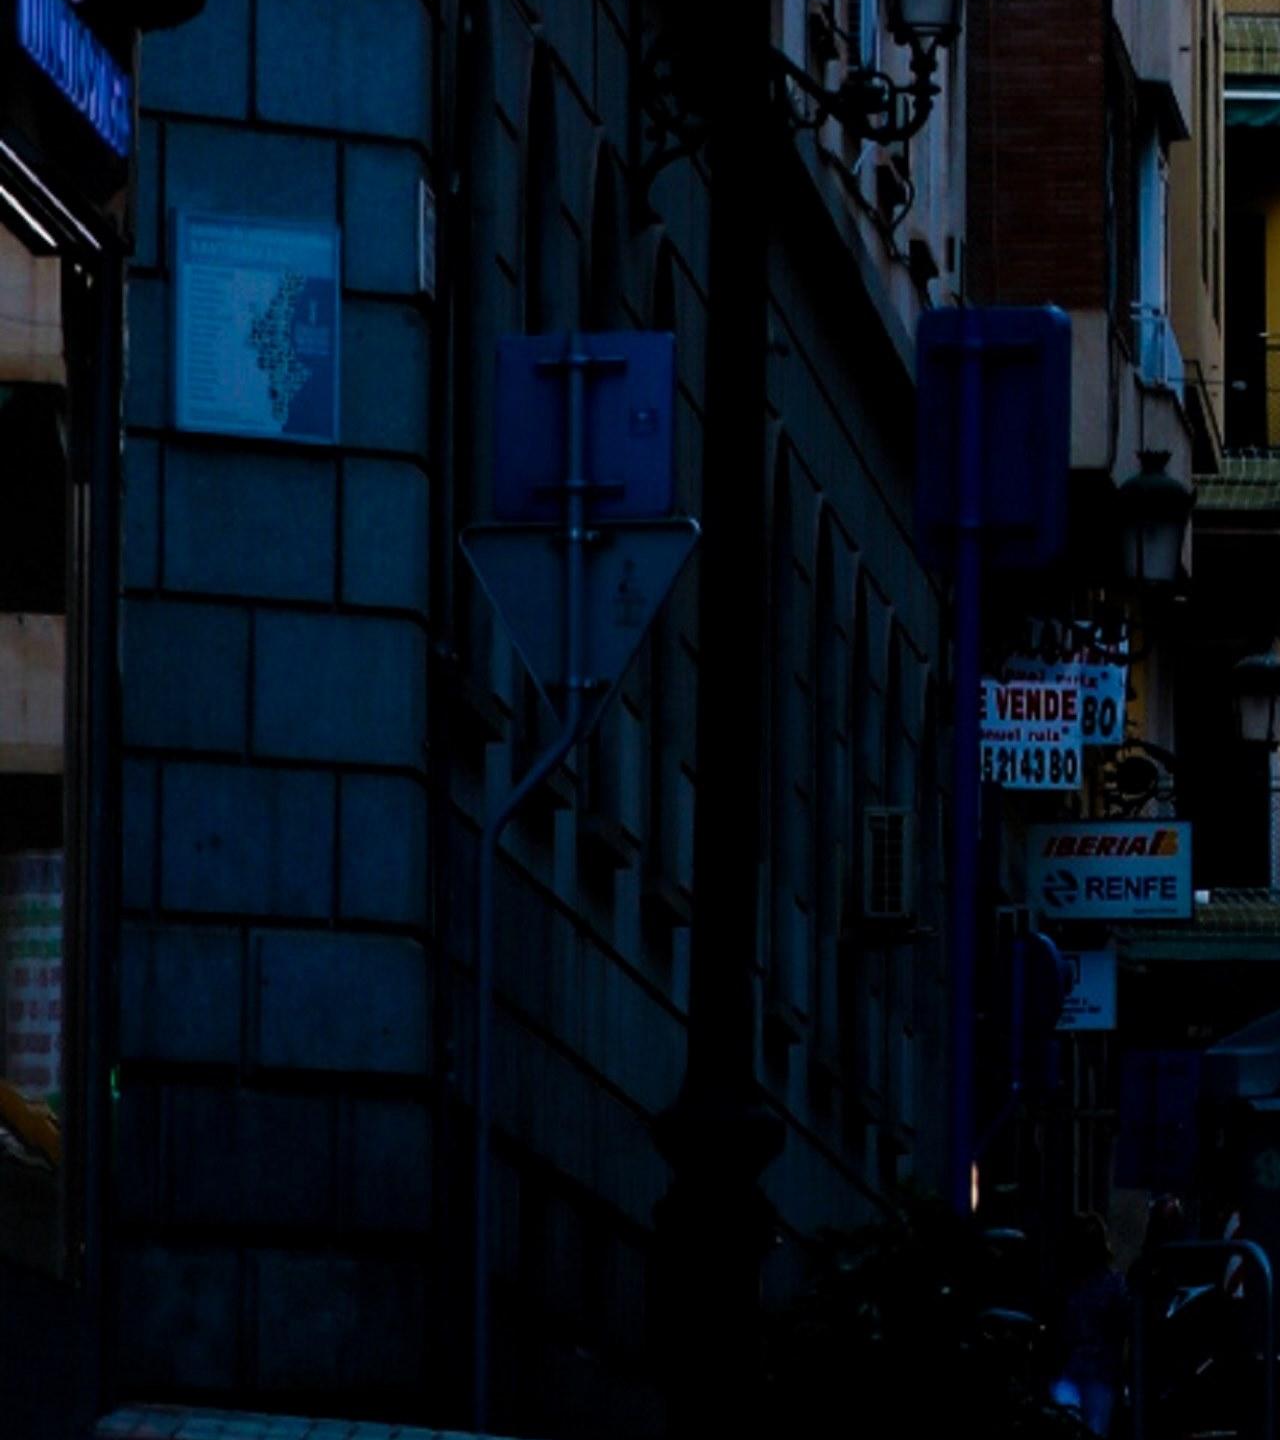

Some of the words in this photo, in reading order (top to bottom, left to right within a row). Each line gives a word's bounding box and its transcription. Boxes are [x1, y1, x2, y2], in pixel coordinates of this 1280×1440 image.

[997, 687, 1077, 720] VENDE
[1045, 836, 1148, 857] IBERIA
[1085, 875, 1178, 901] RENFE
